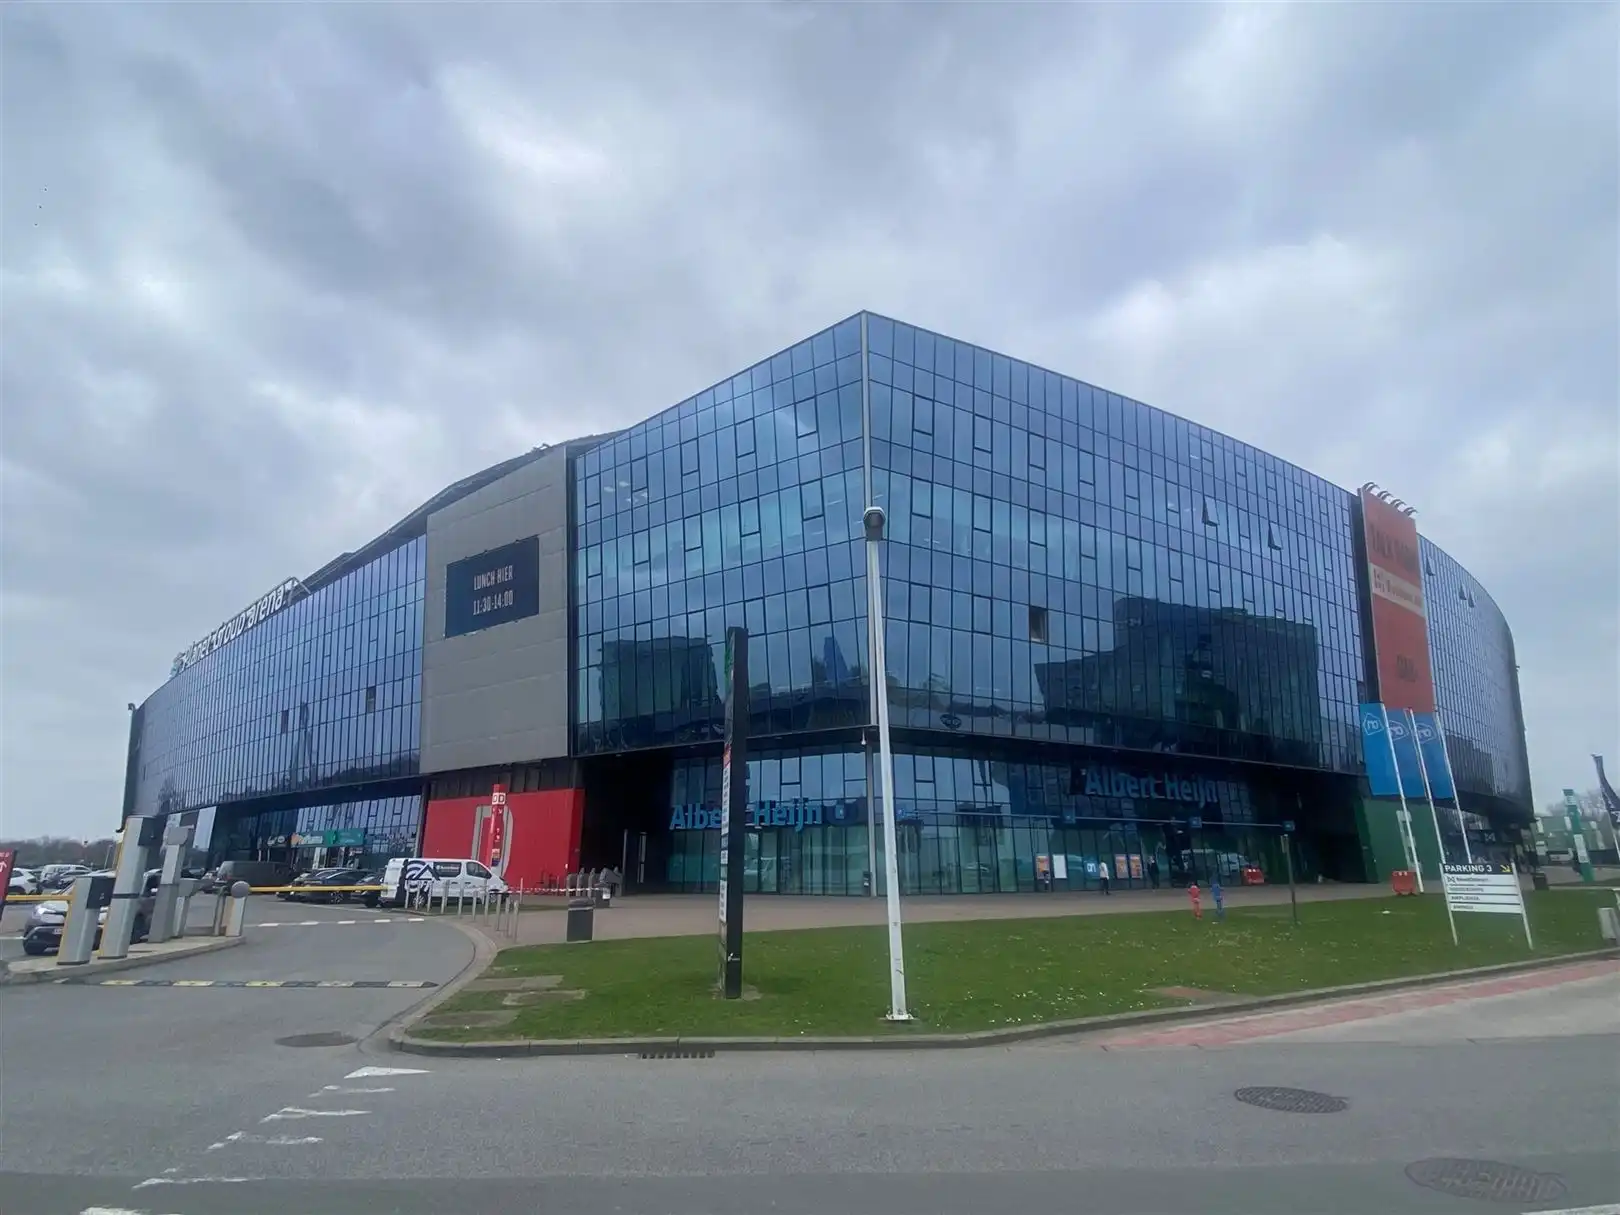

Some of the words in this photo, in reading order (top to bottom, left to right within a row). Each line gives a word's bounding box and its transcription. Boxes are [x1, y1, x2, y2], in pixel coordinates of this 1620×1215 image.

[473, 570, 495, 591] LUNCH
[497, 564, 514, 584] HIER
[1084, 767, 1164, 799] Albert
[1163, 771, 1219, 808] Heijn
[669, 802, 734, 830] Albe
[753, 797, 822, 833] Heijn
[1444, 864, 1485, 873] PARKING
[1486, 864, 1493, 873] 3
